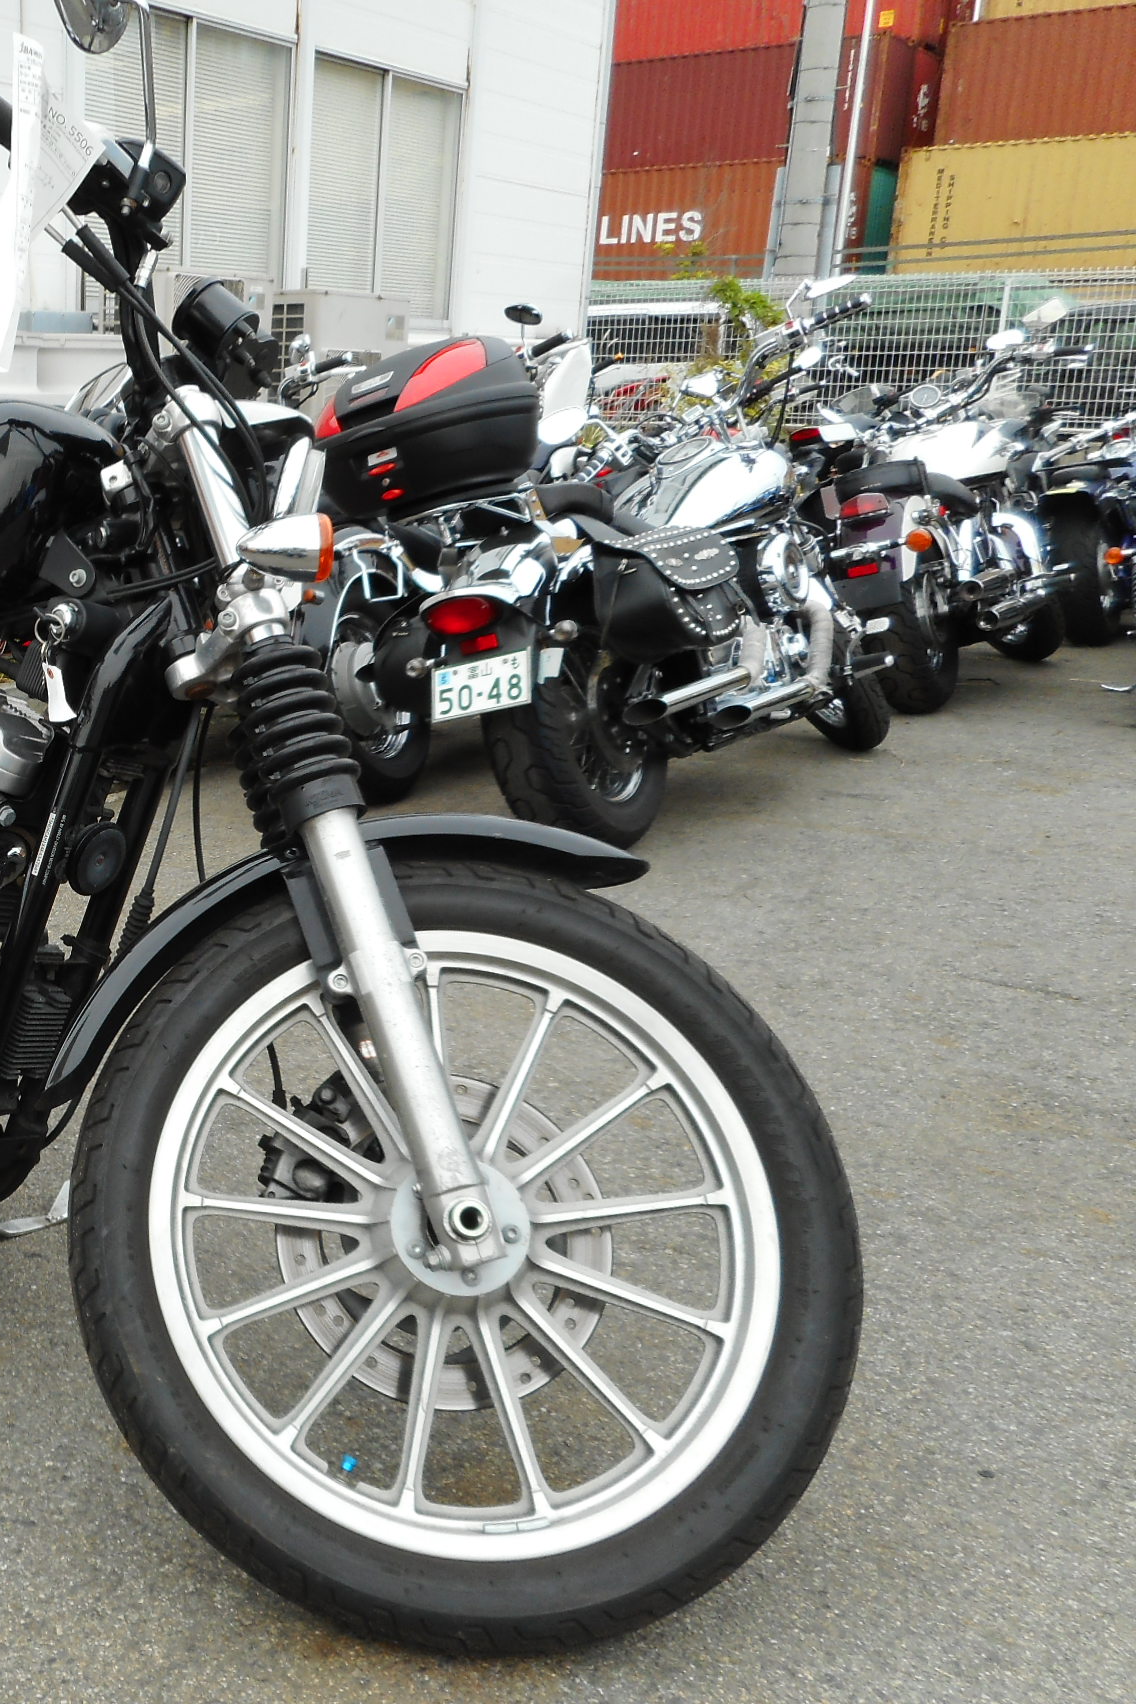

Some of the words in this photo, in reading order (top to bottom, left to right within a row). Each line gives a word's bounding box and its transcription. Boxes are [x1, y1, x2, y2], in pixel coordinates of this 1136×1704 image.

[598, 211, 702, 245] LINES
[926, 168, 944, 257] MEDITERRANEN
[438, 673, 523, 716] 50-48
